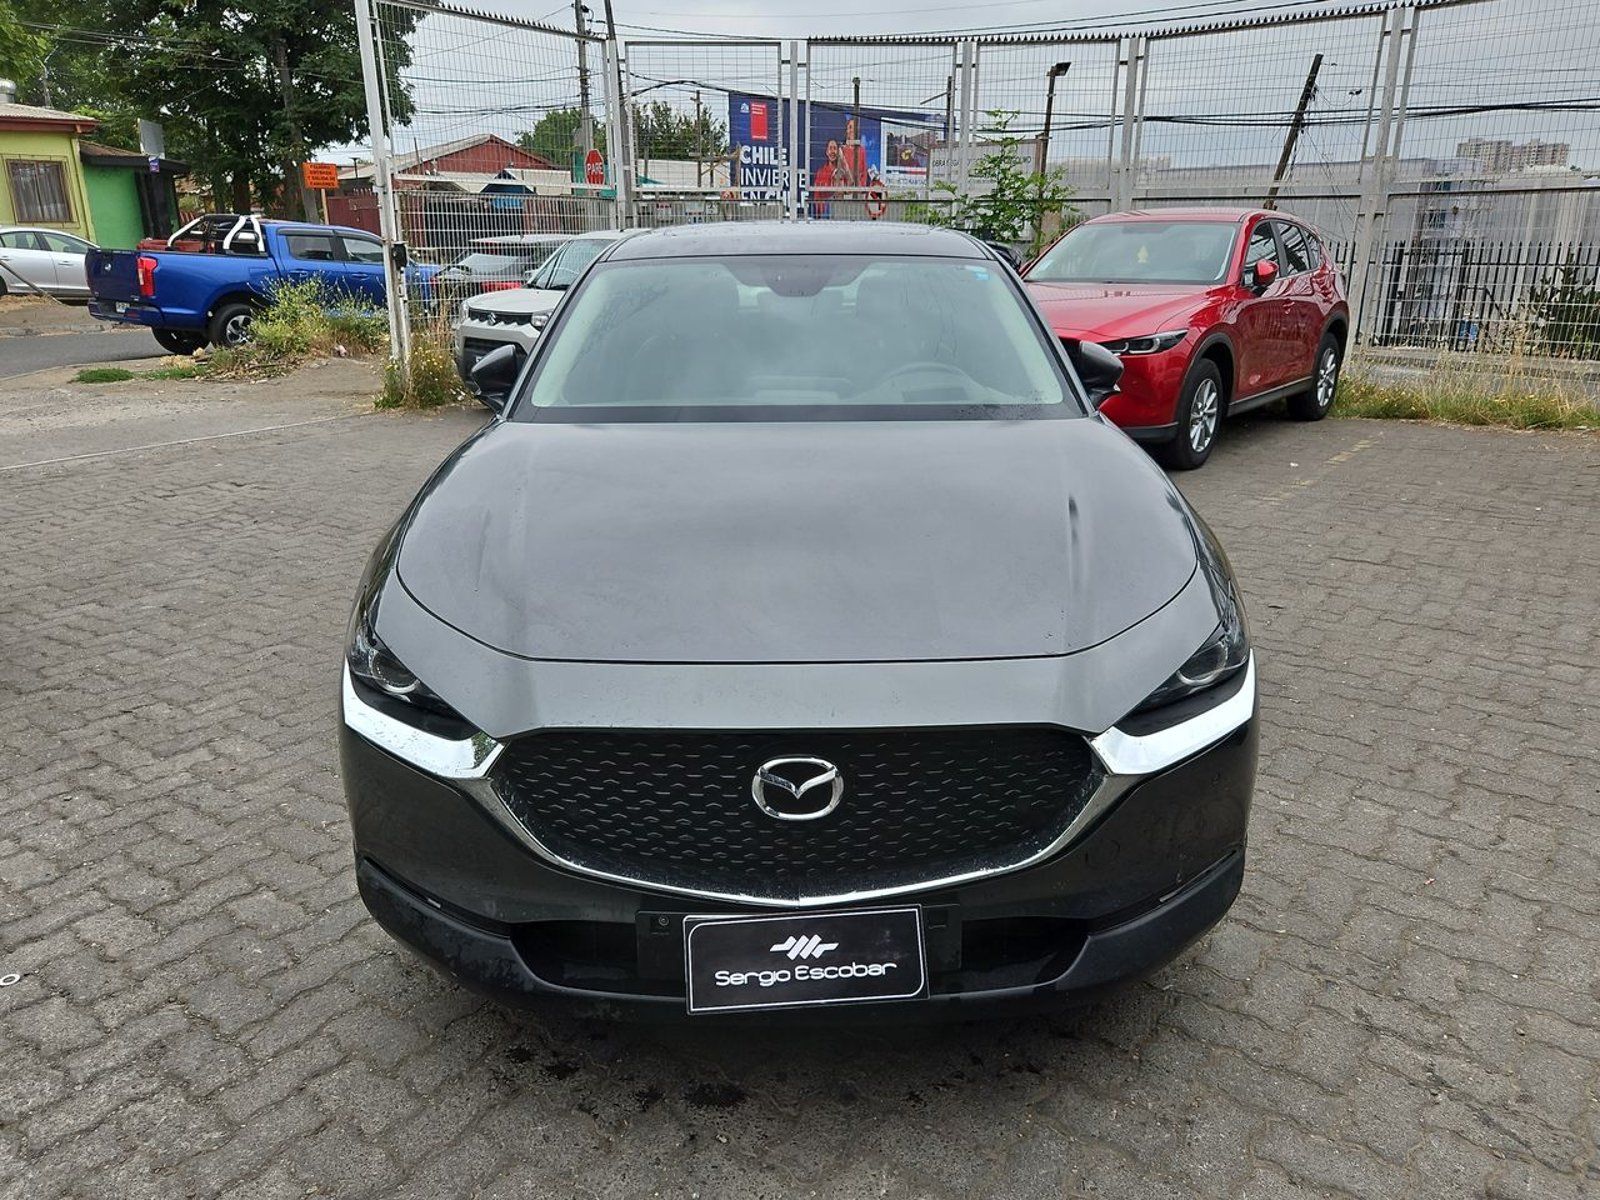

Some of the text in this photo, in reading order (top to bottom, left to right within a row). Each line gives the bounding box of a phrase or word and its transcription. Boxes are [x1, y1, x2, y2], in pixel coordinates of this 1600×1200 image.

[740, 145, 788, 166] CHILE
[587, 162, 604, 175] PARE
[740, 167, 806, 188] INVIERE
[714, 961, 897, 987] Sergio Escobar
